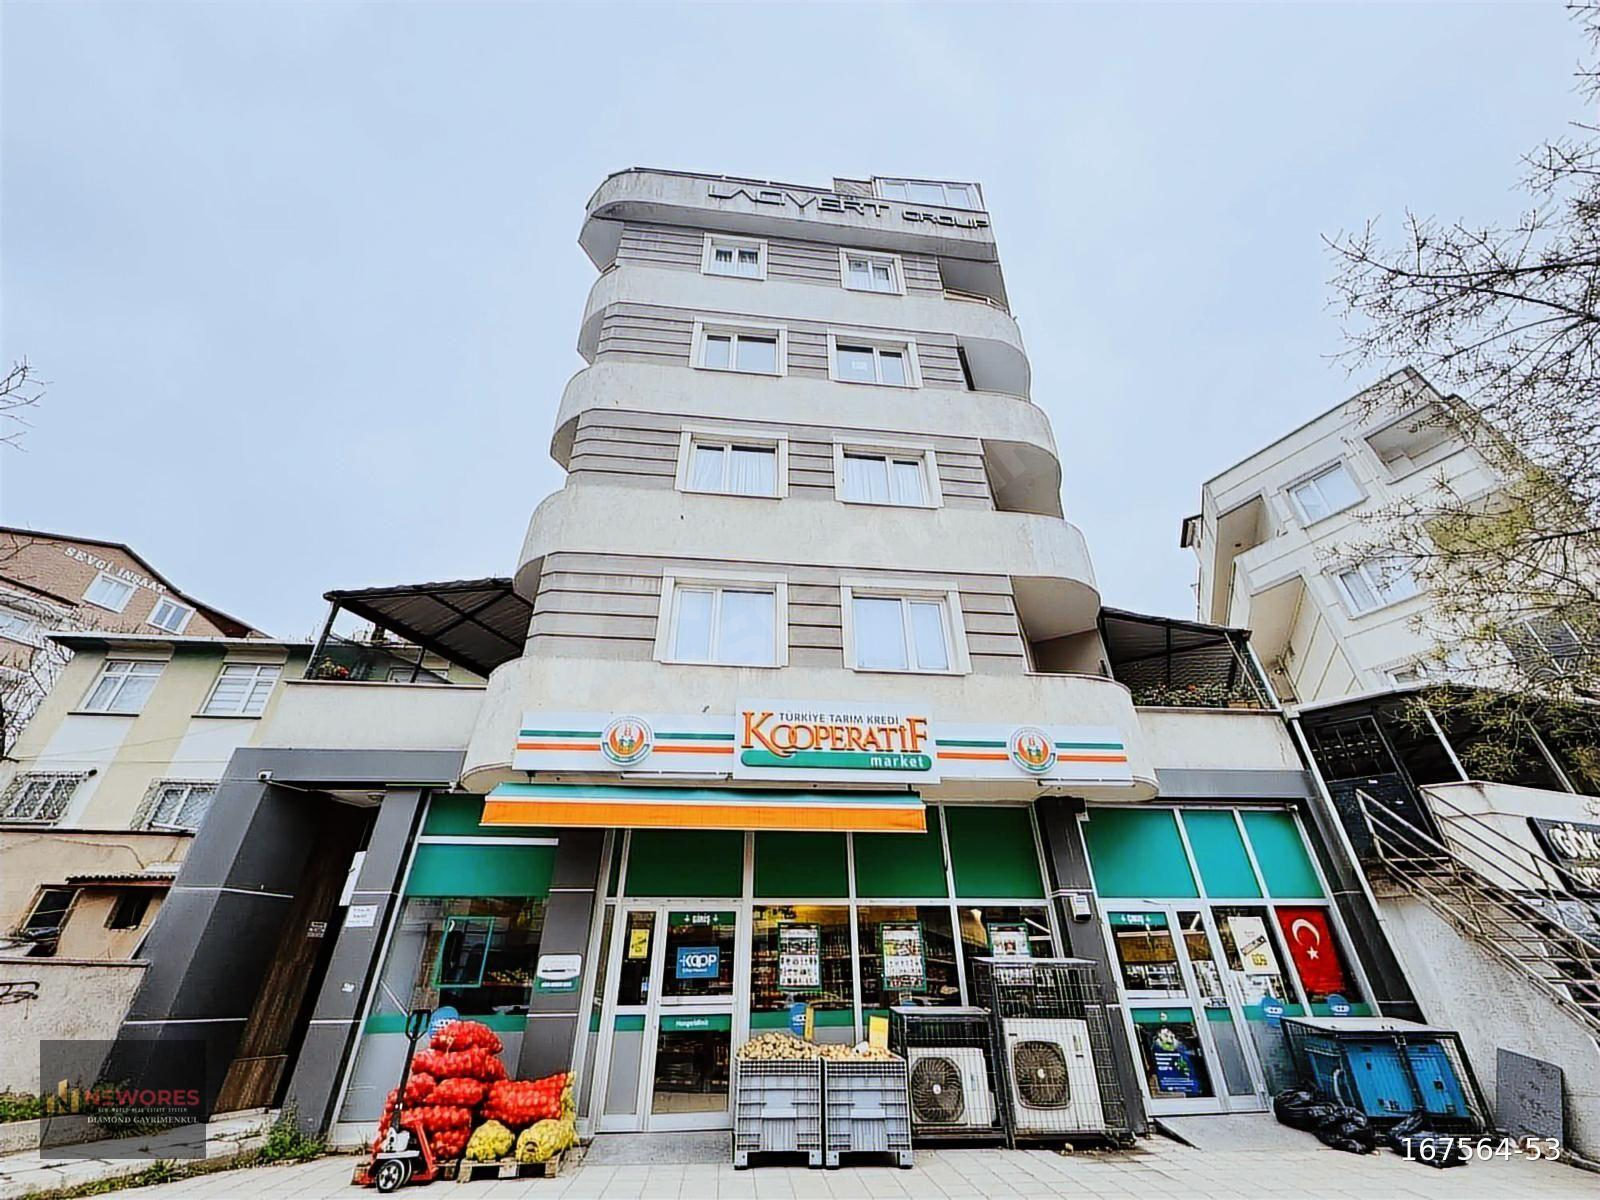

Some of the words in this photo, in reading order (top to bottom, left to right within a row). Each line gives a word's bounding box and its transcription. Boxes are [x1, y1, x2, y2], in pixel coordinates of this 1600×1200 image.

[902, 209, 989, 229] GROUP
[829, 713, 863, 724] TARIM
[867, 712, 899, 725] KREDİ
[870, 754, 924, 768] market
